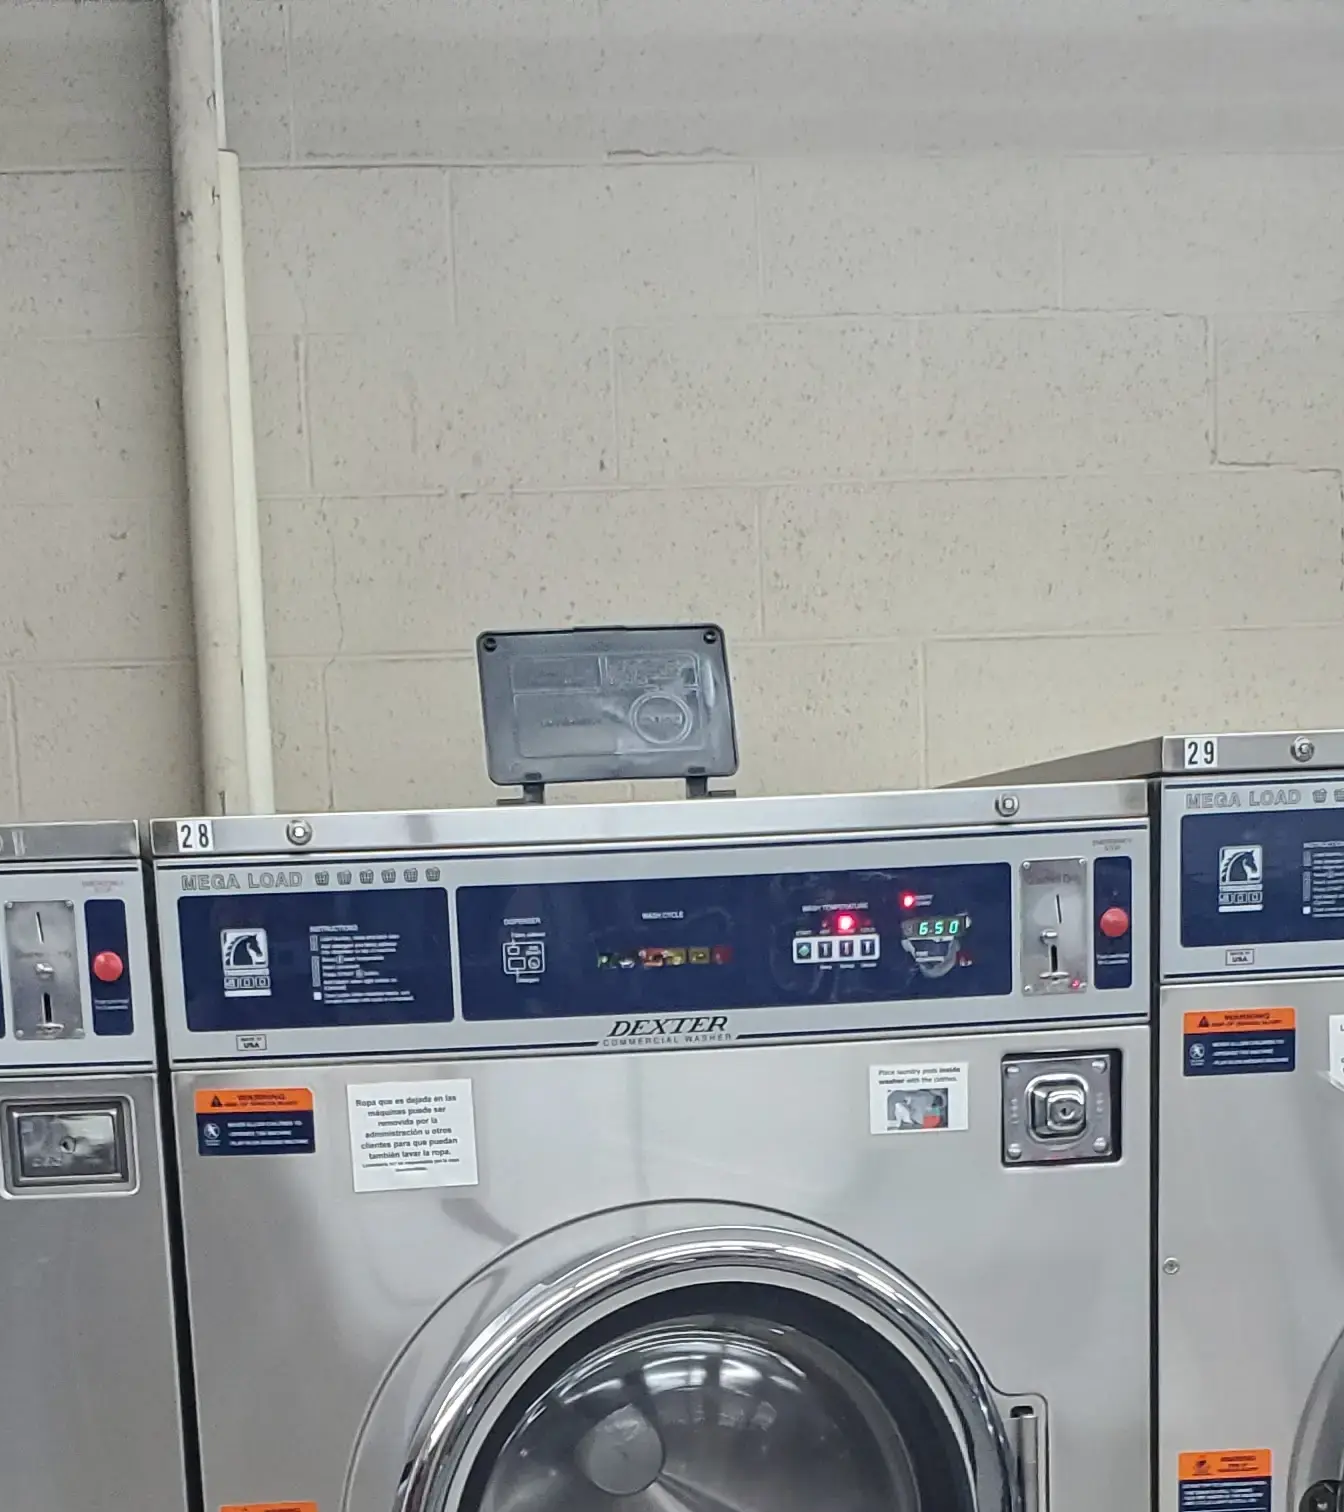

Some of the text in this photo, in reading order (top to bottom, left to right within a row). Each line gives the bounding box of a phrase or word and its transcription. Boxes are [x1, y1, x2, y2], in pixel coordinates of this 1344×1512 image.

[1187, 741, 1214, 765] 29
[1186, 790, 1301, 809] MEGA LOAD
[180, 823, 209, 848] 28
[181, 872, 302, 890] MEGA LOAD
[919, 920, 959, 935] 6.50
[606, 1016, 728, 1037] DEXTER
[603, 1033, 731, 1047] COMMERCIAL WASHER
[356, 1099, 376, 1107] Ropa
[408, 1107, 432, 1115] puede
[365, 1128, 423, 1138] administración
[429, 1138, 458, 1146] puedan
[369, 1152, 400, 1160] también
[432, 1149, 451, 1157] ropa.
